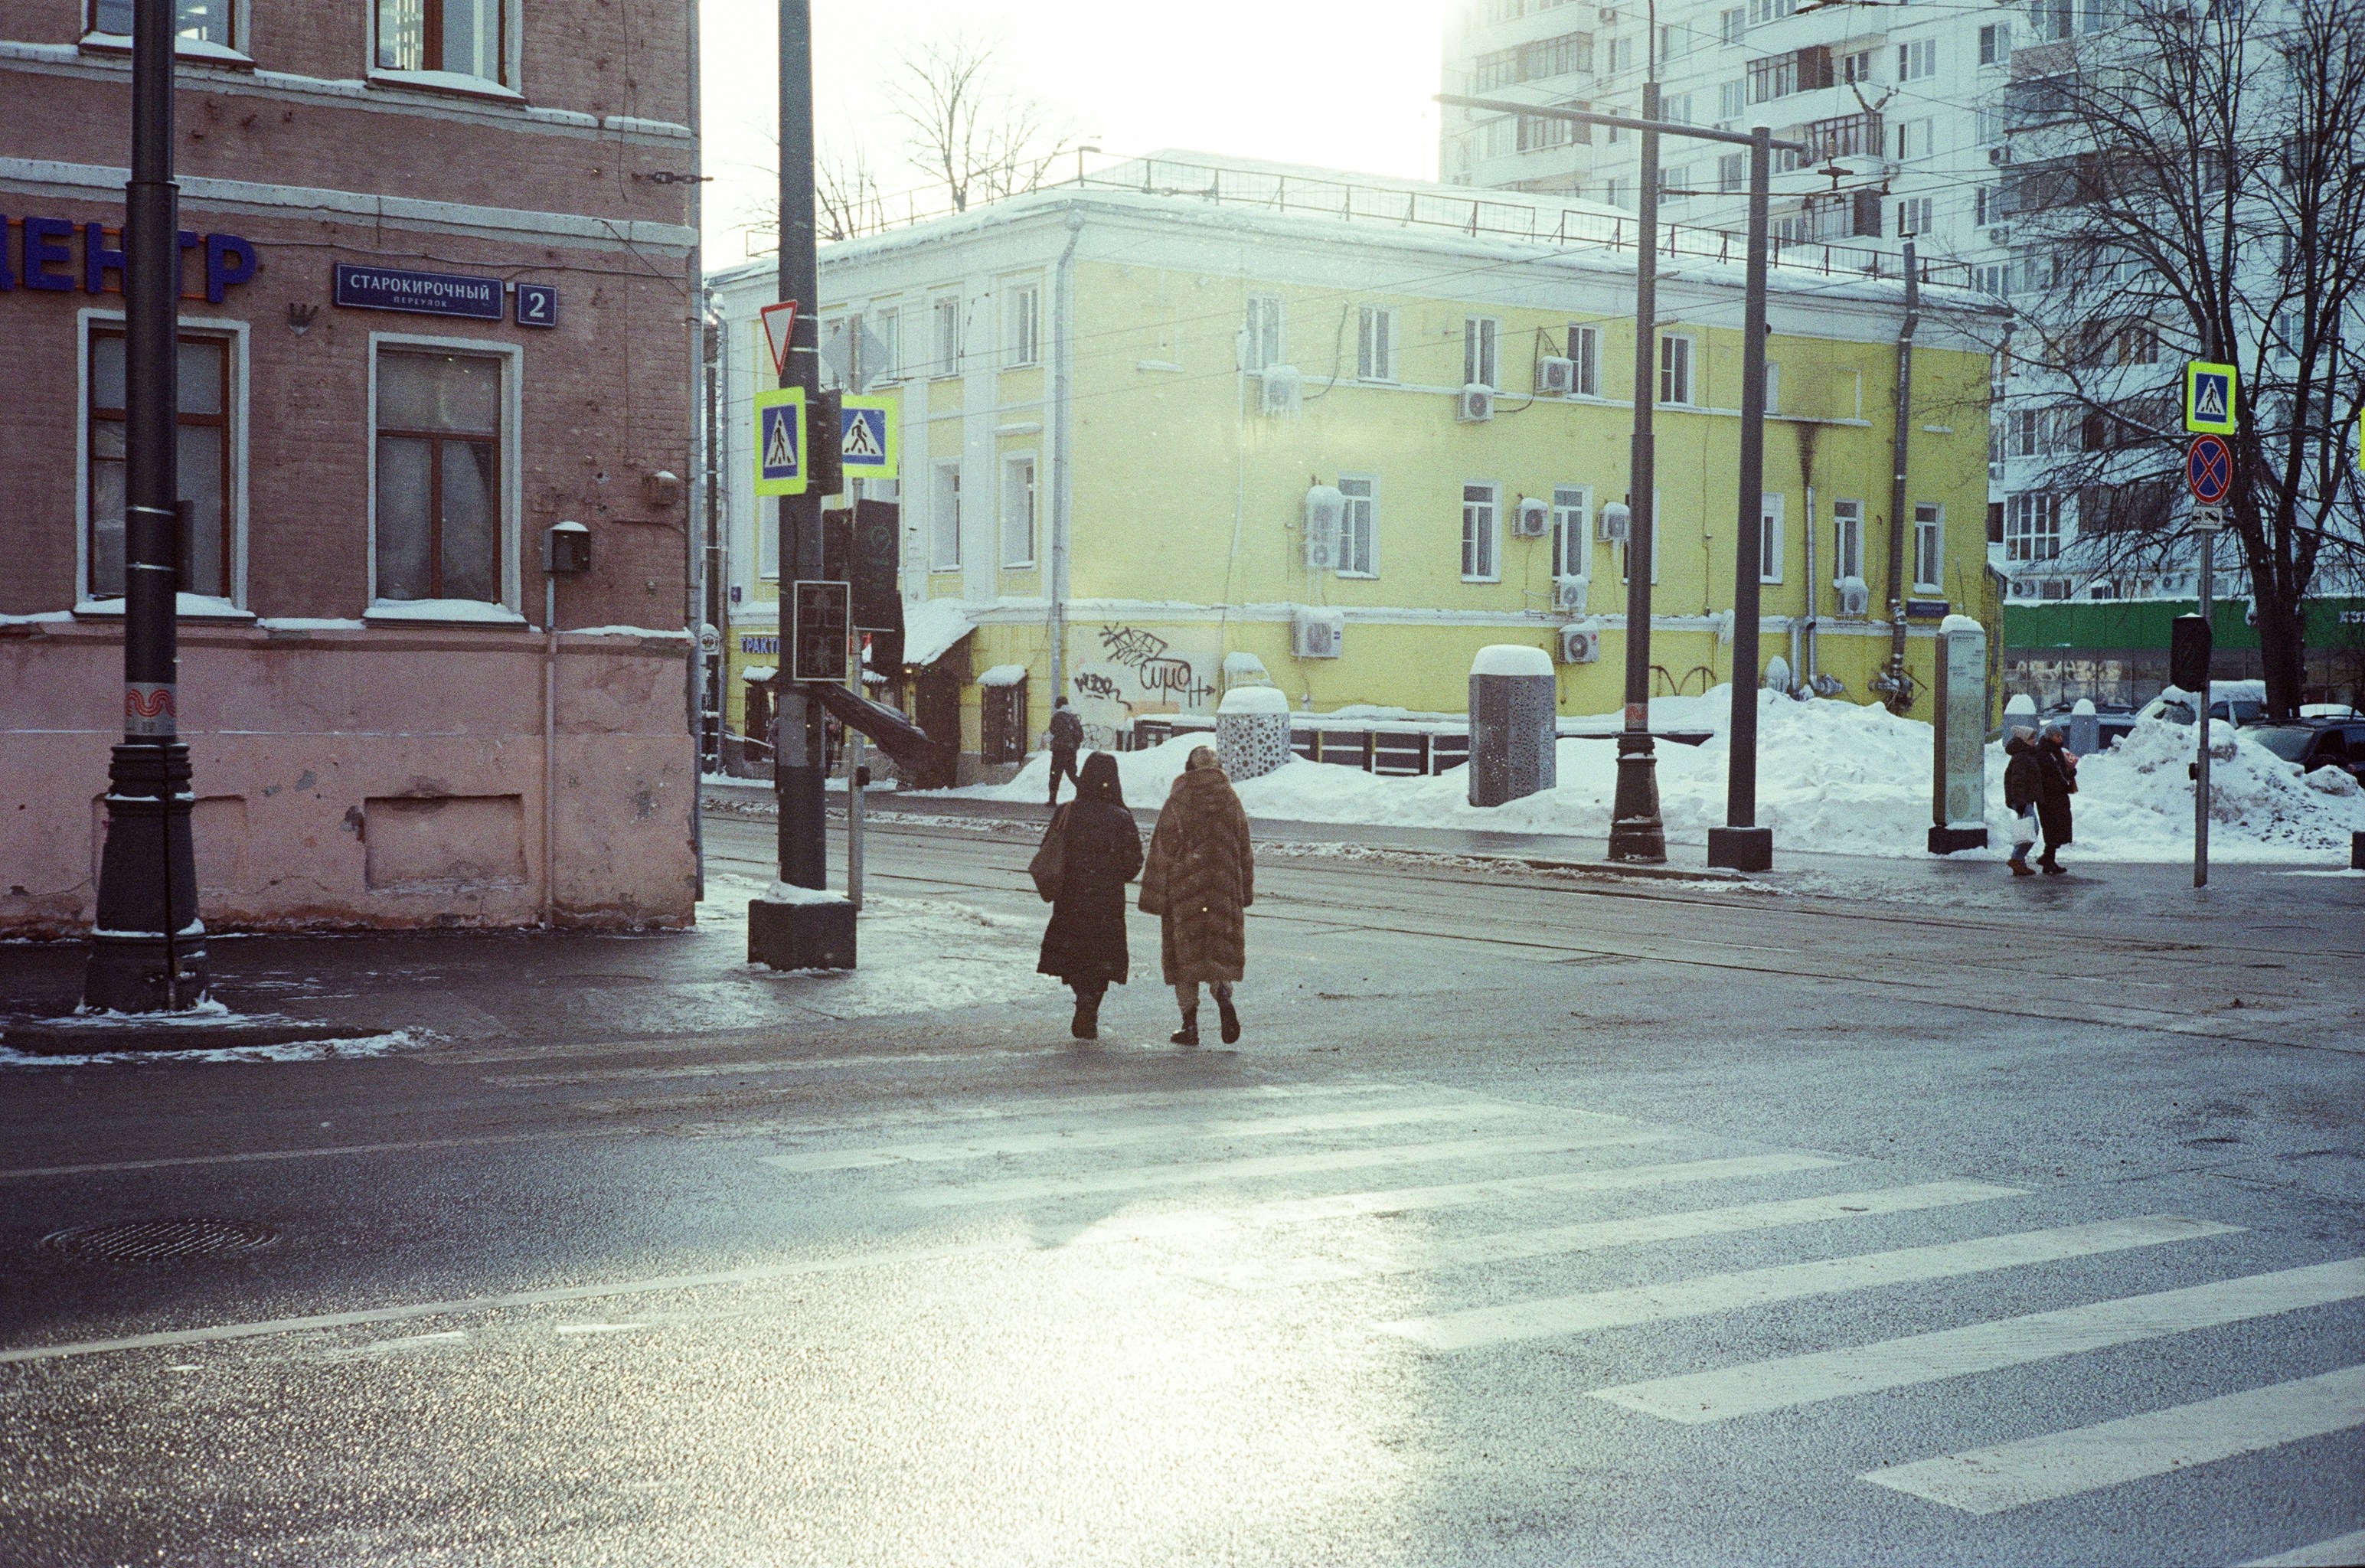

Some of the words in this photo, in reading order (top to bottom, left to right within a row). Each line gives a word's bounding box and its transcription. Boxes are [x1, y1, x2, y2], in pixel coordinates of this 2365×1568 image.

[0, 214, 257, 303] ЕНР
[350, 274, 490, 301] СТАРОКИРОЧНЫЙ
[393, 296, 447, 308] ПЕРЕУЛОК
[529, 292, 546, 318] 2
